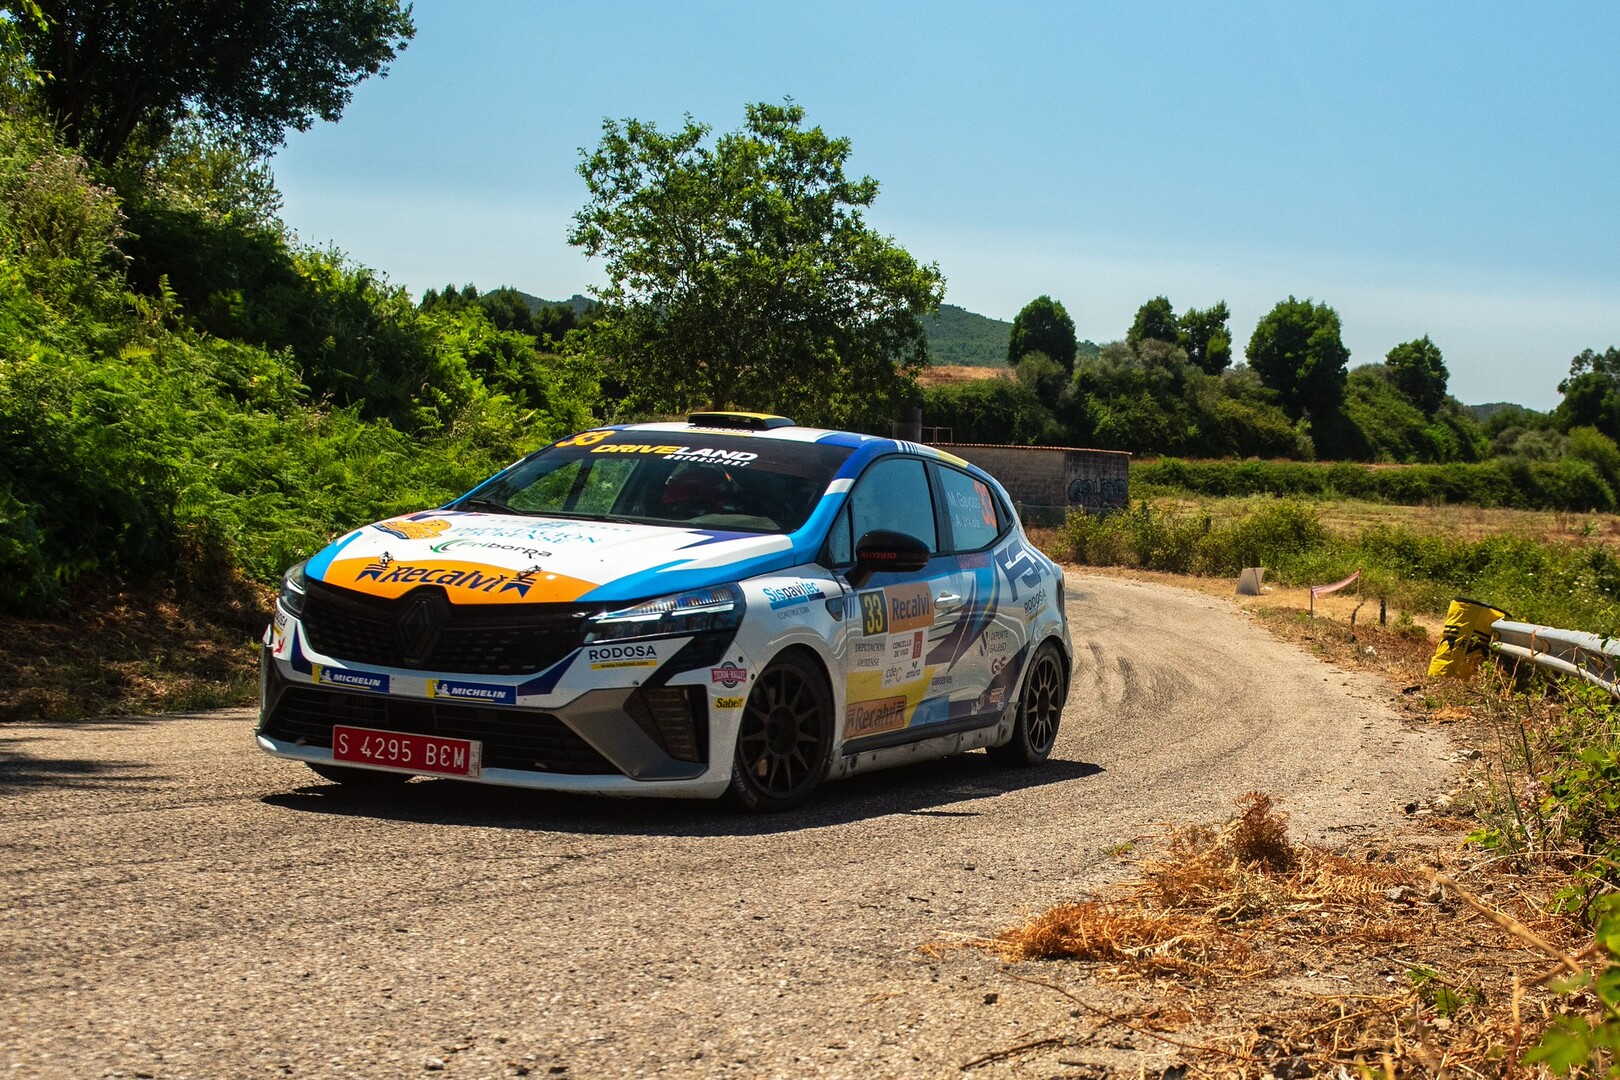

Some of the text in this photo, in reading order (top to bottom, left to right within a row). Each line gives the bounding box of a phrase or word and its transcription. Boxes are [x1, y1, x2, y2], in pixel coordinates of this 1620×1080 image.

[555, 430, 616, 448] 33
[590, 444, 758, 461] DRIVELAND
[662, 454, 751, 467] MOTORSPORT
[974, 480, 998, 528] 33
[379, 565, 507, 593] Recalvi
[763, 580, 821, 602] Sispavitec
[891, 593, 930, 621] Recalvi
[1024, 588, 1047, 613] RODOSA
[863, 594, 884, 633] 33
[892, 639, 912, 649] CONCELLO
[990, 630, 1009, 641] DEPORTE
[589, 645, 657, 660] RODOSA
[900, 648, 909, 656] VIGO
[600, 660, 649, 669] www.rodosa.com
[333, 673, 381, 687] MICHELIN
[451, 687, 506, 699] MICHELIN
[716, 698, 744, 709] Sabelt
[855, 702, 896, 730] Recalvi
[338, 733, 349, 755] S
[360, 736, 412, 762] 4295
[426, 743, 465, 769] BEM
